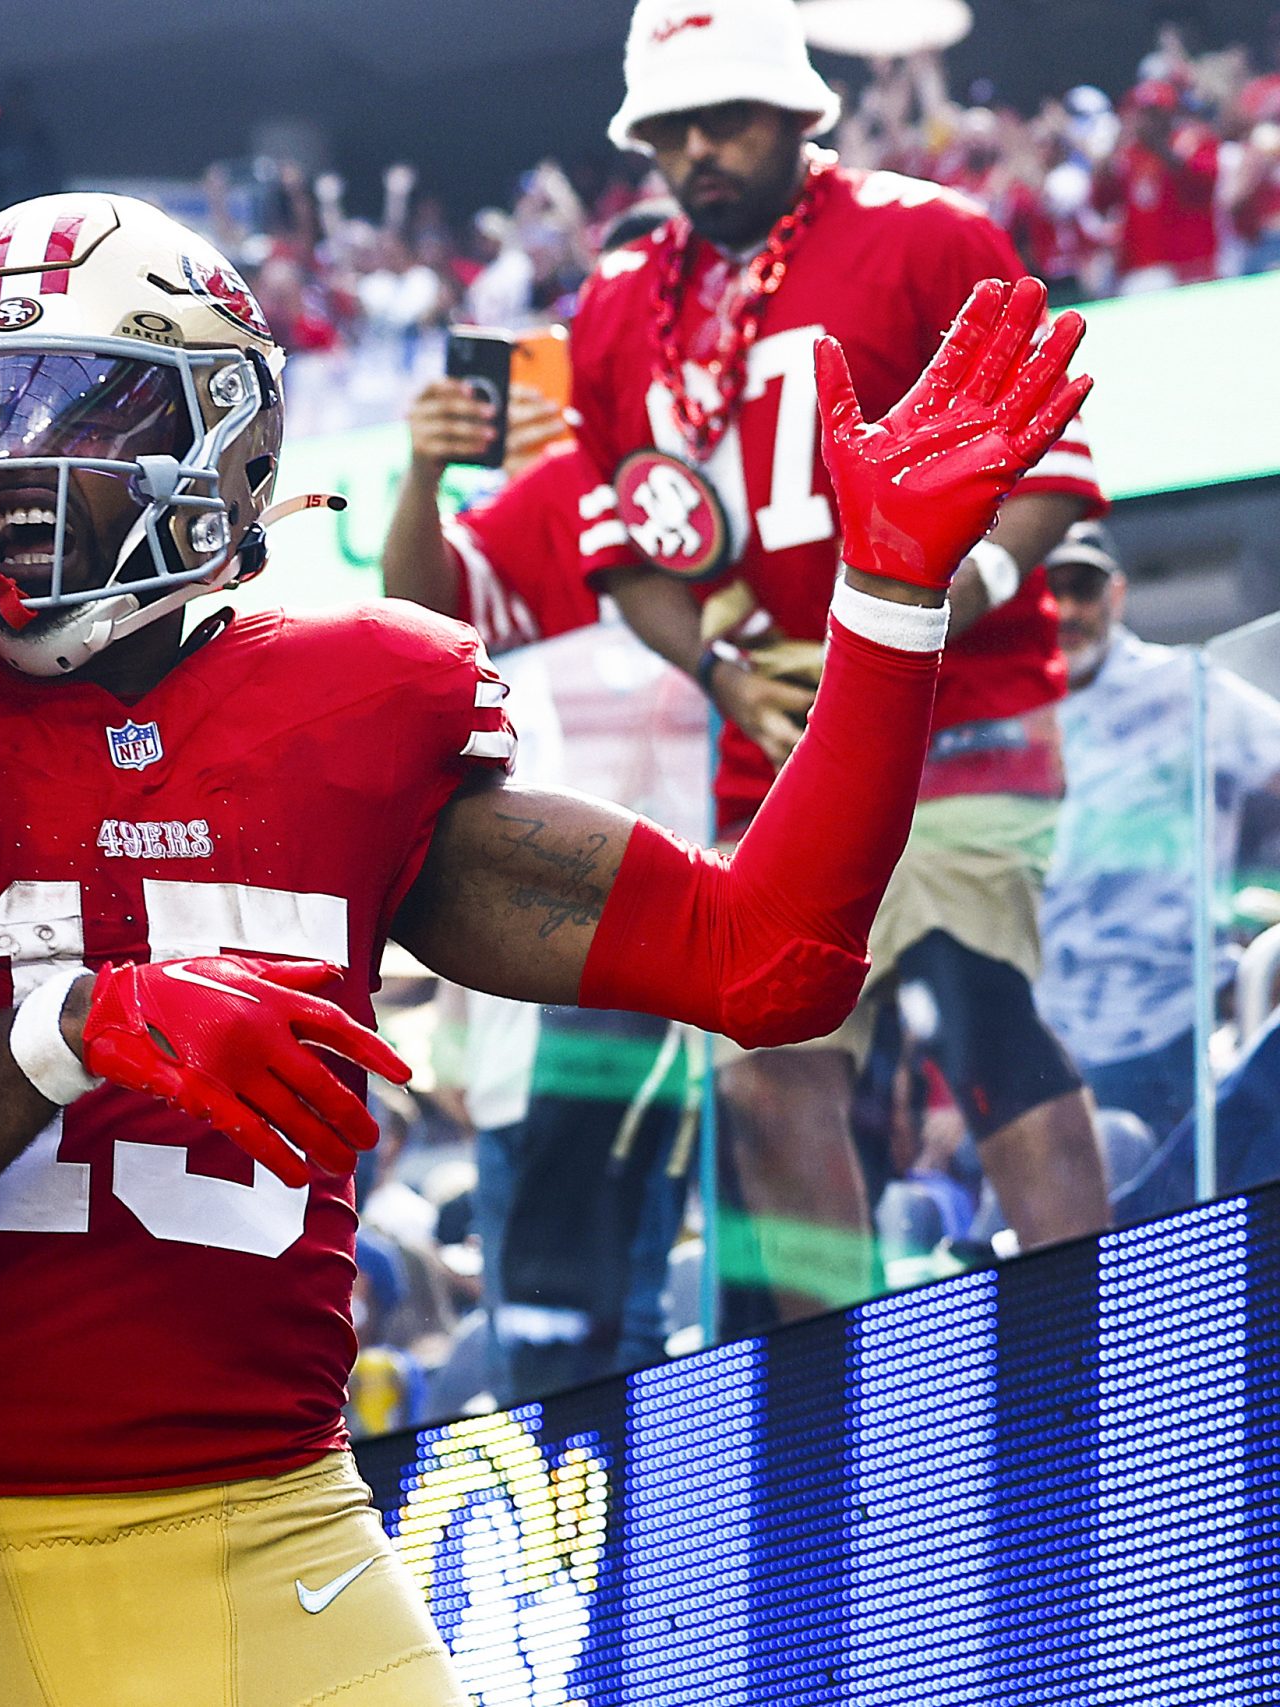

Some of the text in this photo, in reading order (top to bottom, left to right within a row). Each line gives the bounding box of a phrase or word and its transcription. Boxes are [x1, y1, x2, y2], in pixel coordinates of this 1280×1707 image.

[122, 326, 180, 346] OAKLEY
[305, 494, 322, 508] 15
[117, 740, 154, 761] NFL
[96, 819, 214, 859] 49ERS
